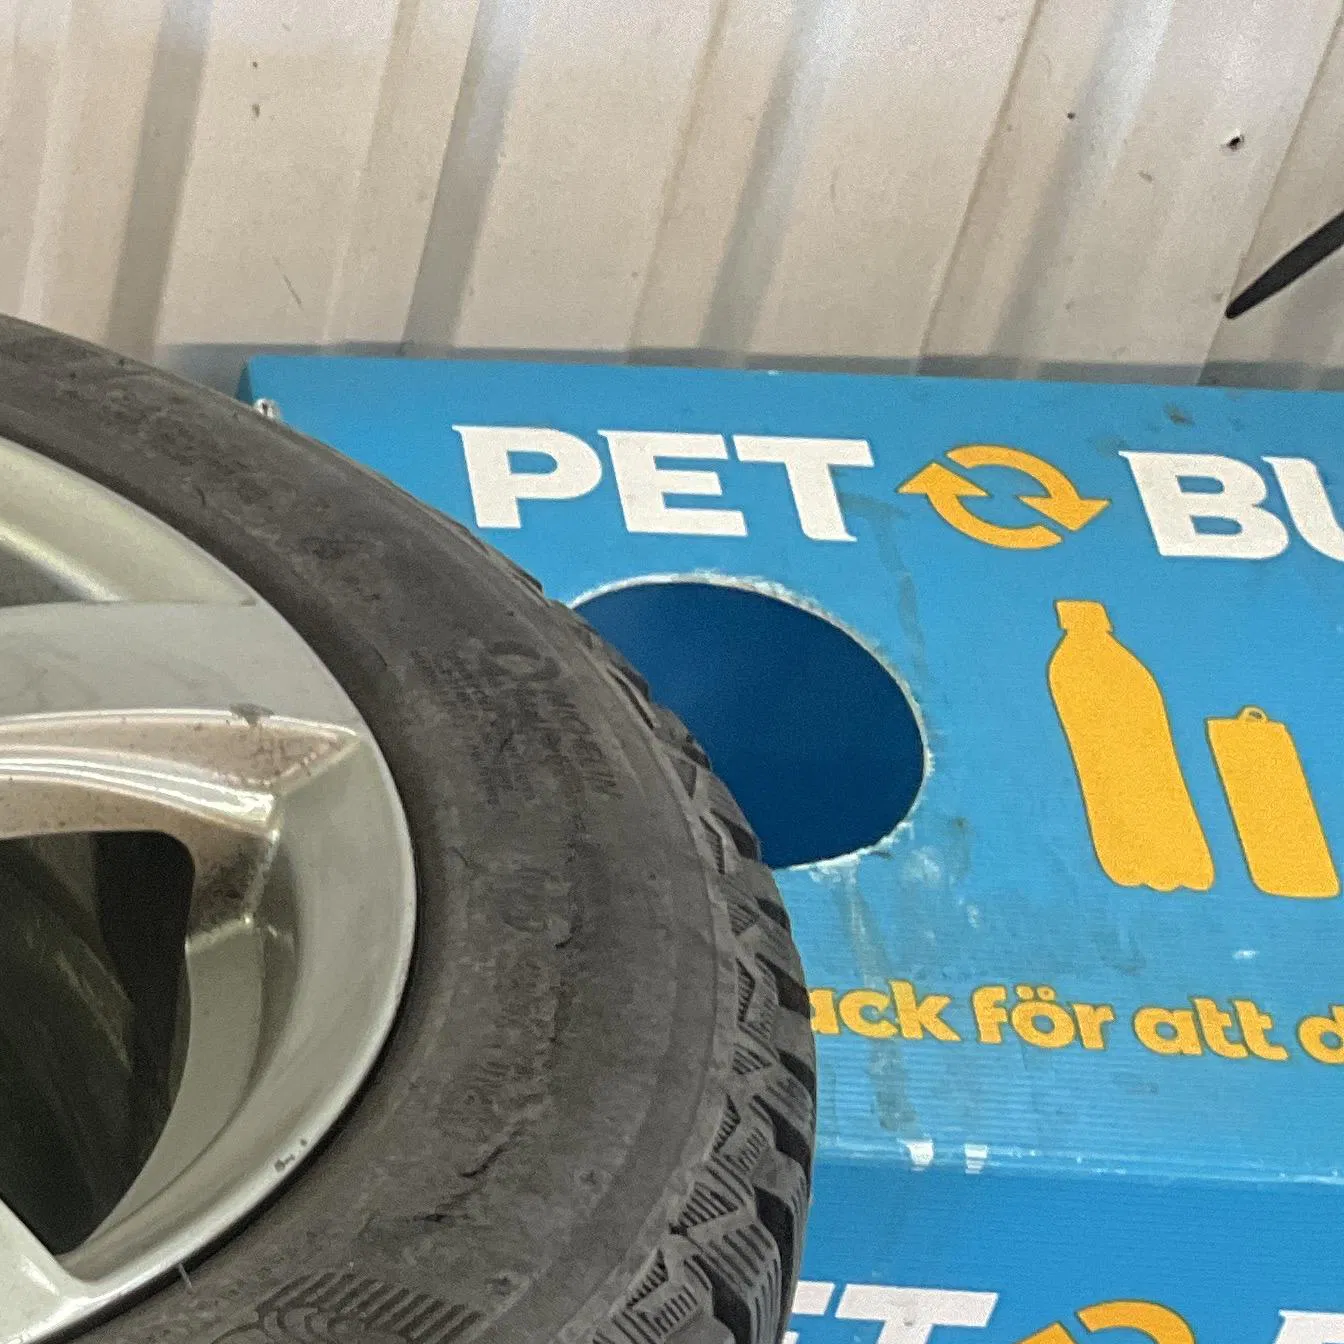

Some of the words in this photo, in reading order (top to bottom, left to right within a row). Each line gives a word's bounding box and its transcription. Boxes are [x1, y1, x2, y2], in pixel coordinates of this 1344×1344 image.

[454, 425, 874, 541] PET
[973, 985, 1114, 1050] för
[1133, 998, 1289, 1061] att
